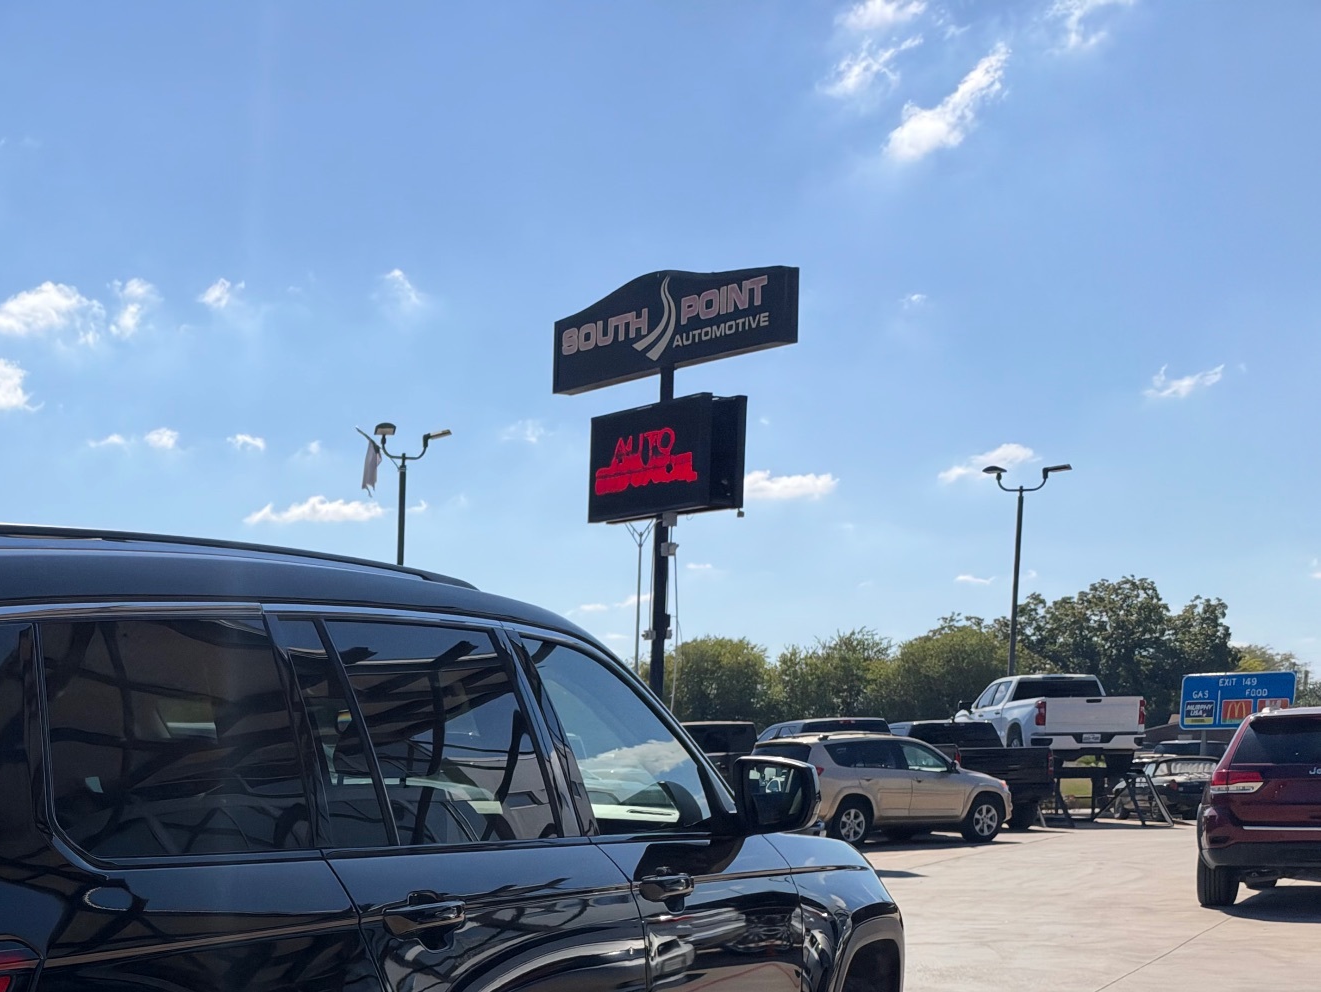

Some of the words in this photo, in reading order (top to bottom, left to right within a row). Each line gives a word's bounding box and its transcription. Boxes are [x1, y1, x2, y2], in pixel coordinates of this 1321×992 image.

[562, 307, 648, 355] SOUTH
[681, 275, 768, 325] POINT
[672, 312, 769, 348] AUTOMOTIVE
[1192, 690, 1209, 699] GAS
[1245, 688, 1268, 697] FOOD
[1219, 678, 1237, 687] EXIT
[1242, 677, 1258, 686] 149
